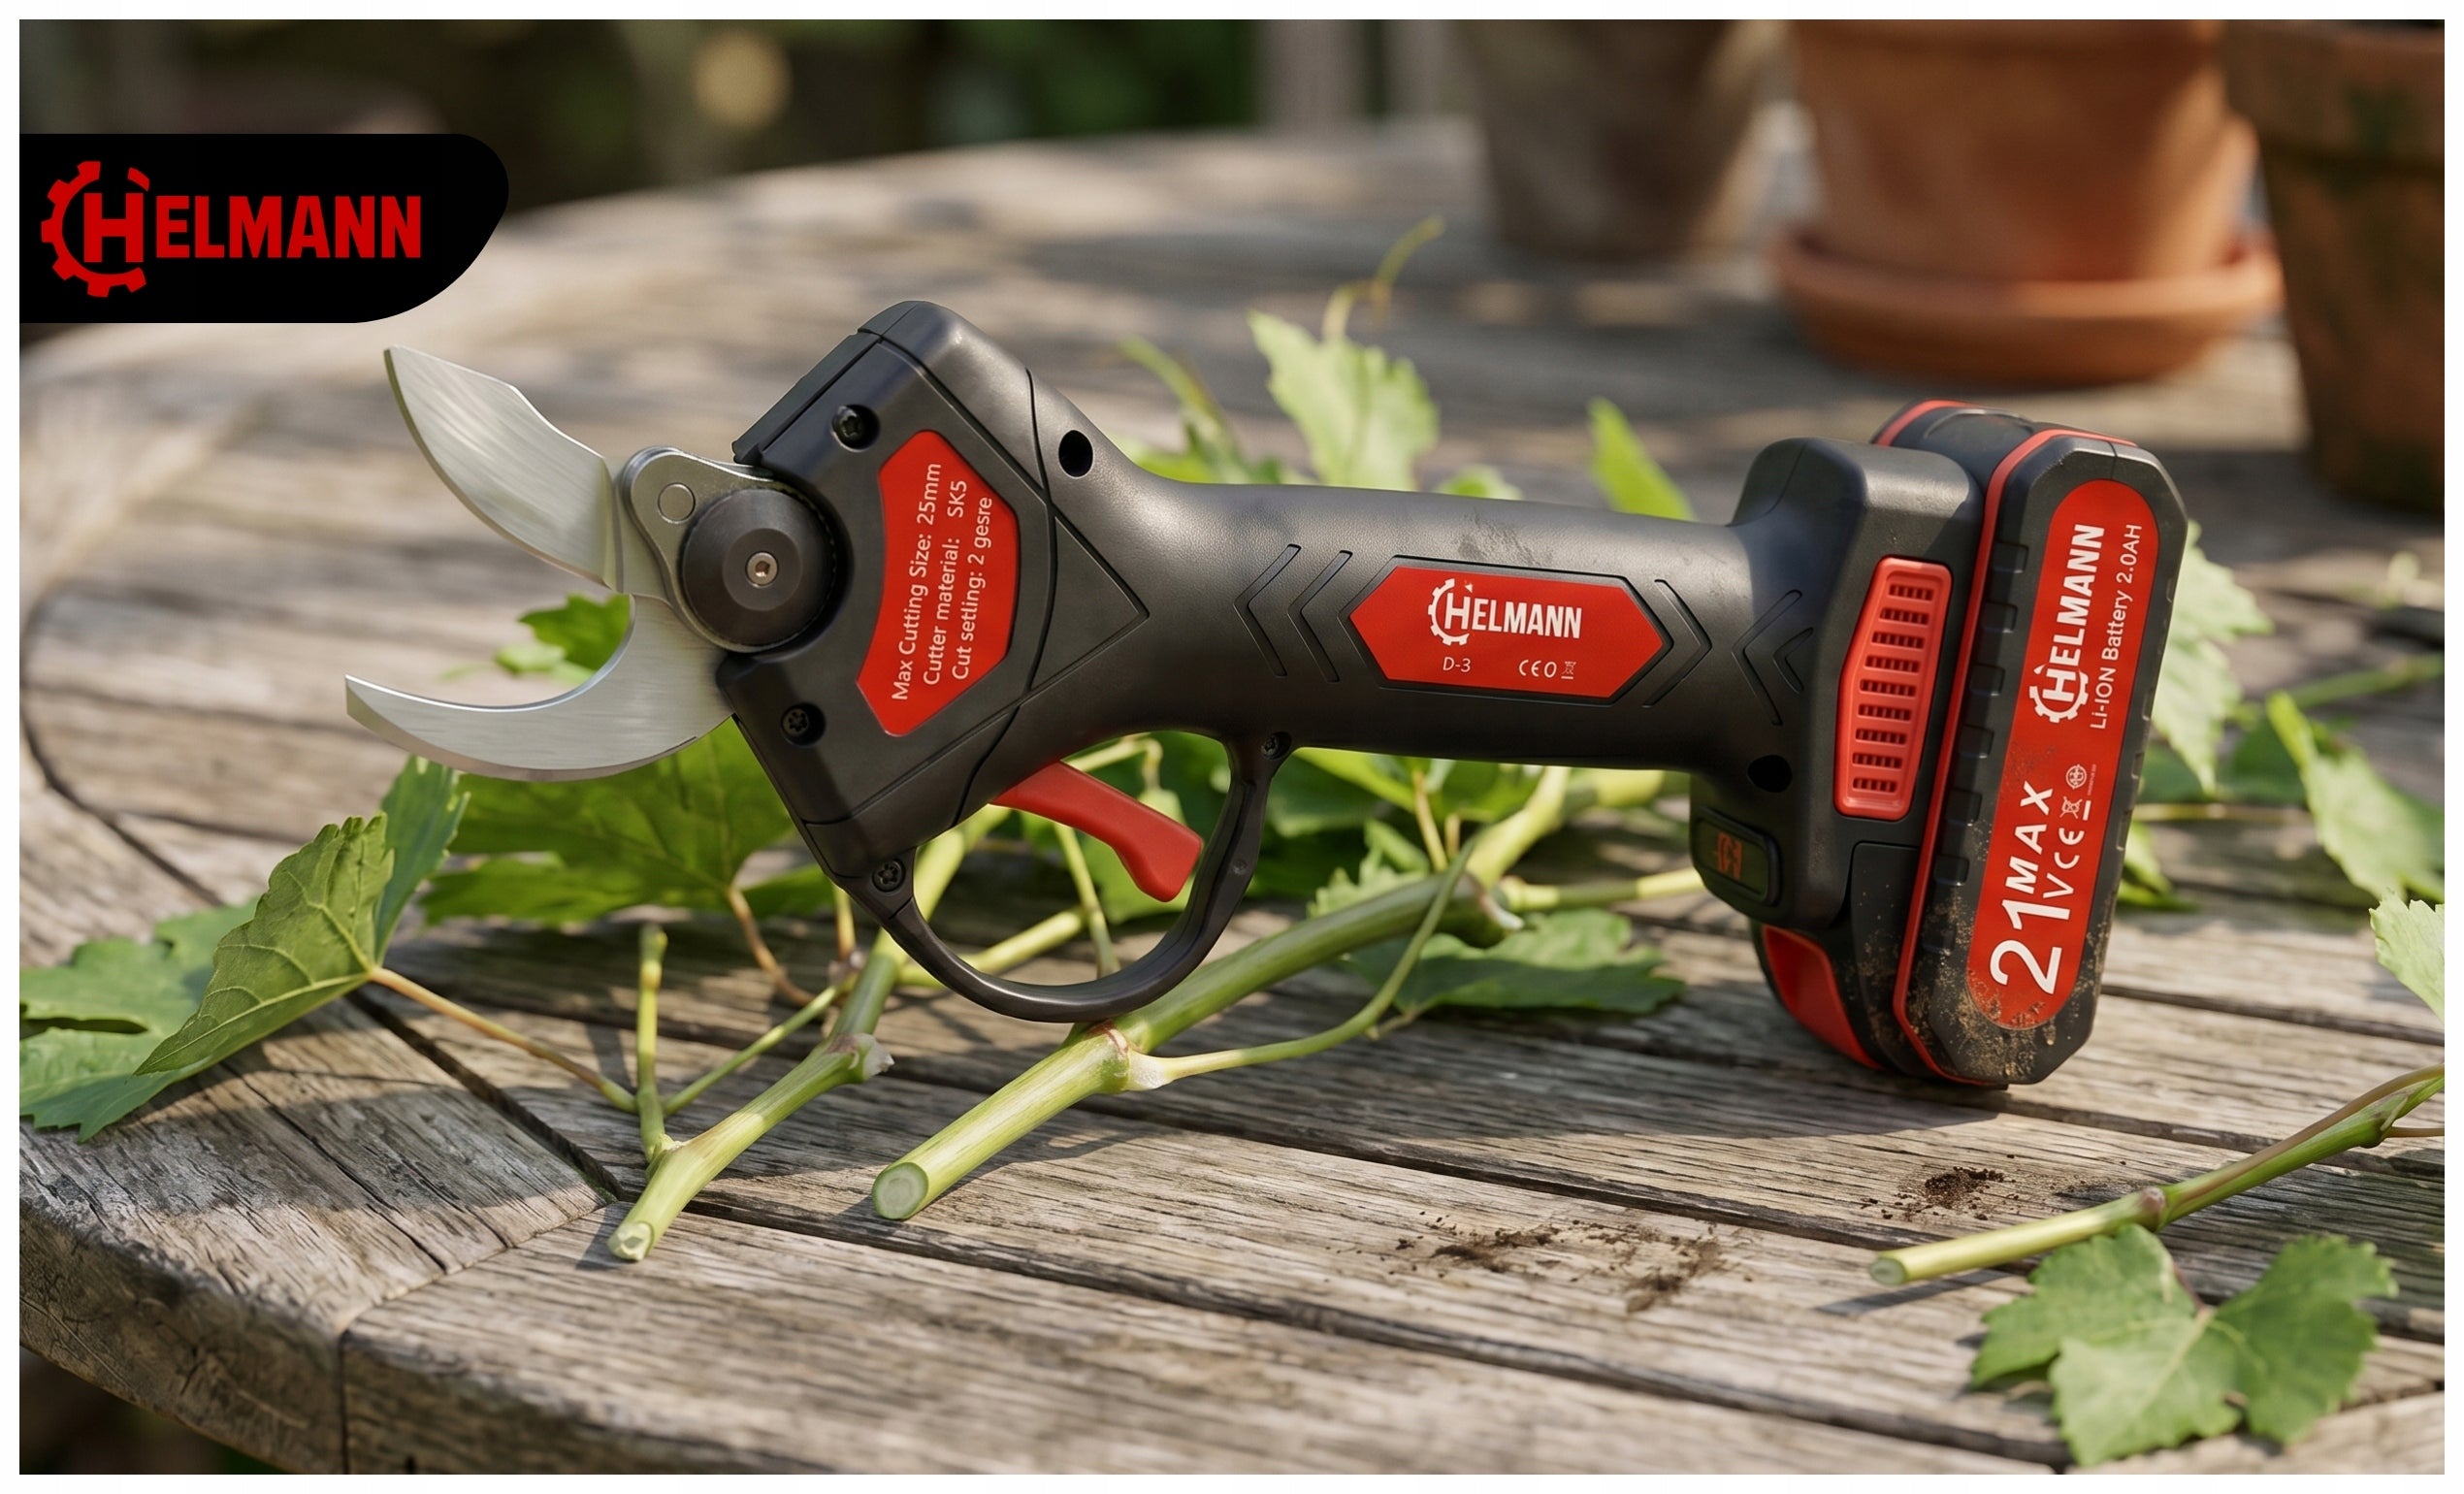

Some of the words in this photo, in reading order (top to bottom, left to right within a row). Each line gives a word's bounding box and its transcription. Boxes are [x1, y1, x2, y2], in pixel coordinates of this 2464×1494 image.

[917, 463, 941, 525] 25mm
[947, 480, 967, 518] SK5
[974, 497, 992, 548] gesre
[908, 534, 932, 579] Size:
[936, 537, 960, 621] material:
[967, 555, 985, 566] 2
[2116, 524, 2142, 584] 2.0AH
[898, 584, 928, 654] Cutting
[1444, 592, 1582, 639] HELMANN
[2042, 524, 2105, 702] HELMANN
[2101, 589, 2133, 661] Battery
[892, 659, 914, 700] Max
[924, 626, 947, 685] Cutter
[952, 638, 972, 680] Cut
[1443, 657, 1471, 673] D-3
[2090, 666, 2117, 730] Li-ION
[2005, 780, 2054, 894] MAX
[1990, 899, 2071, 994] 21
